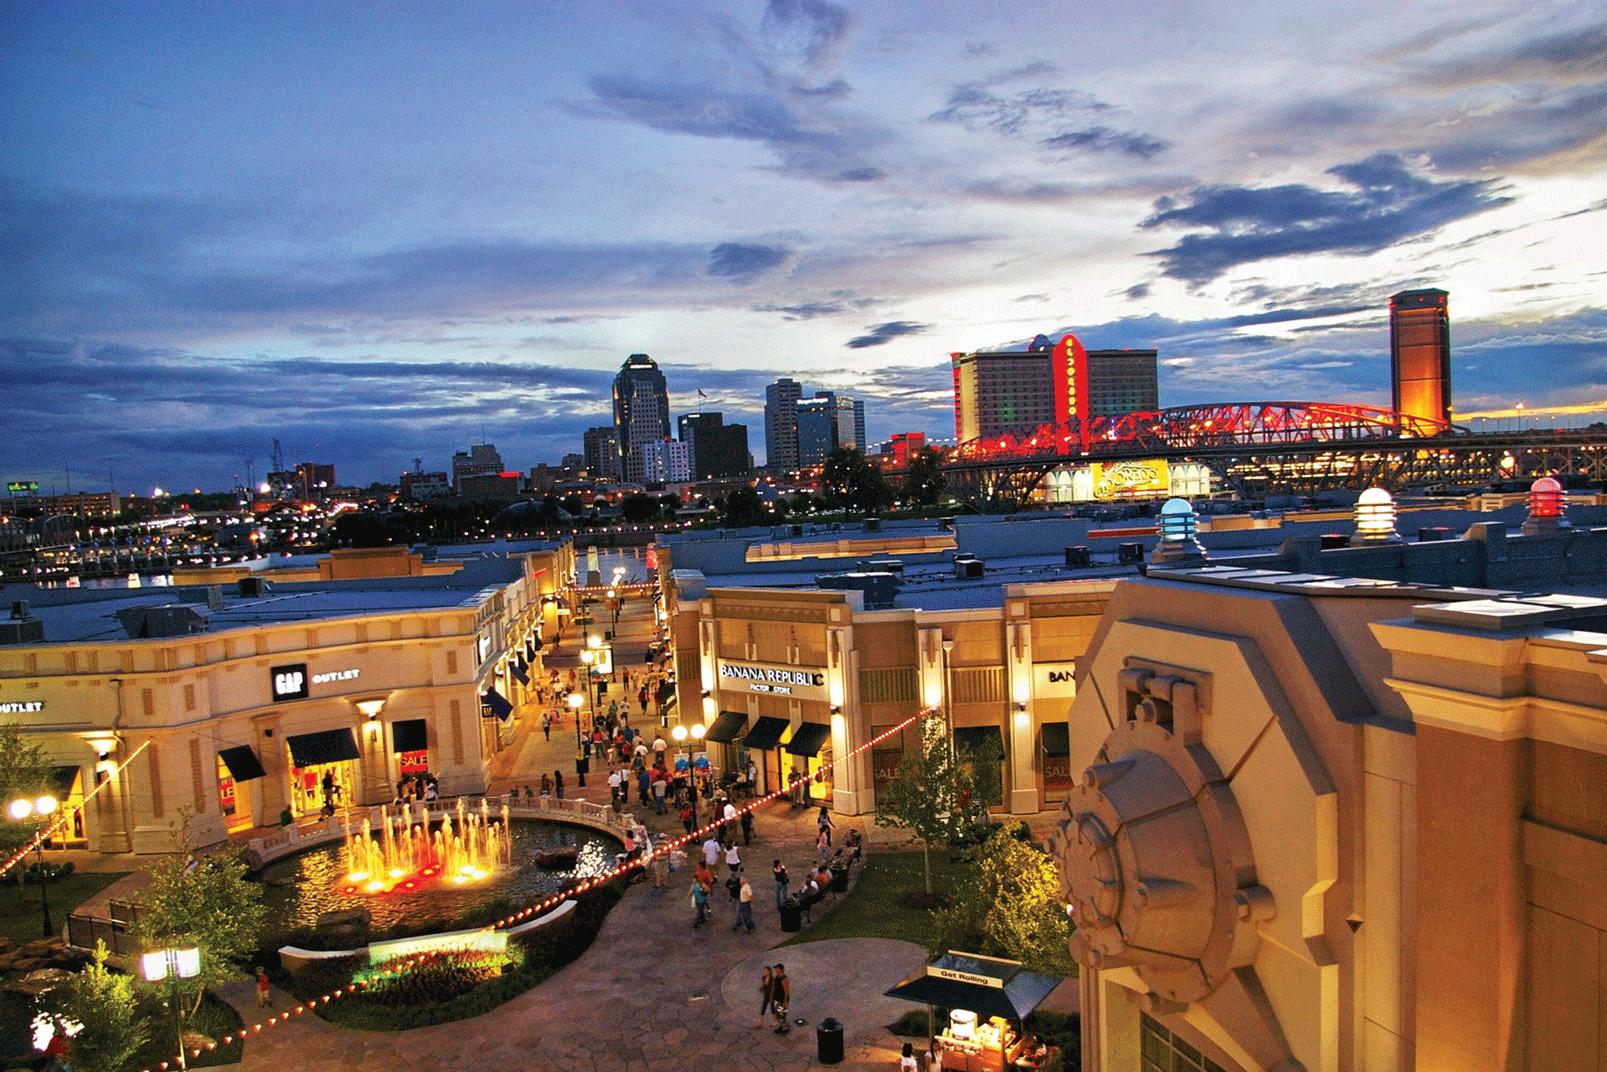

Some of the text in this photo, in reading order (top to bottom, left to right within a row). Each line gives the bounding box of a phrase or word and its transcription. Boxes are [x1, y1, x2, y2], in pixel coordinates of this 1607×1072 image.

[275, 668, 360, 695] GAP OUTLET
[720, 664, 825, 687] BANANA REPUBLIC
[0, 702, 42, 713] UTLET
[400, 755, 429, 768] SALE
[941, 970, 989, 985] Get Rolling
